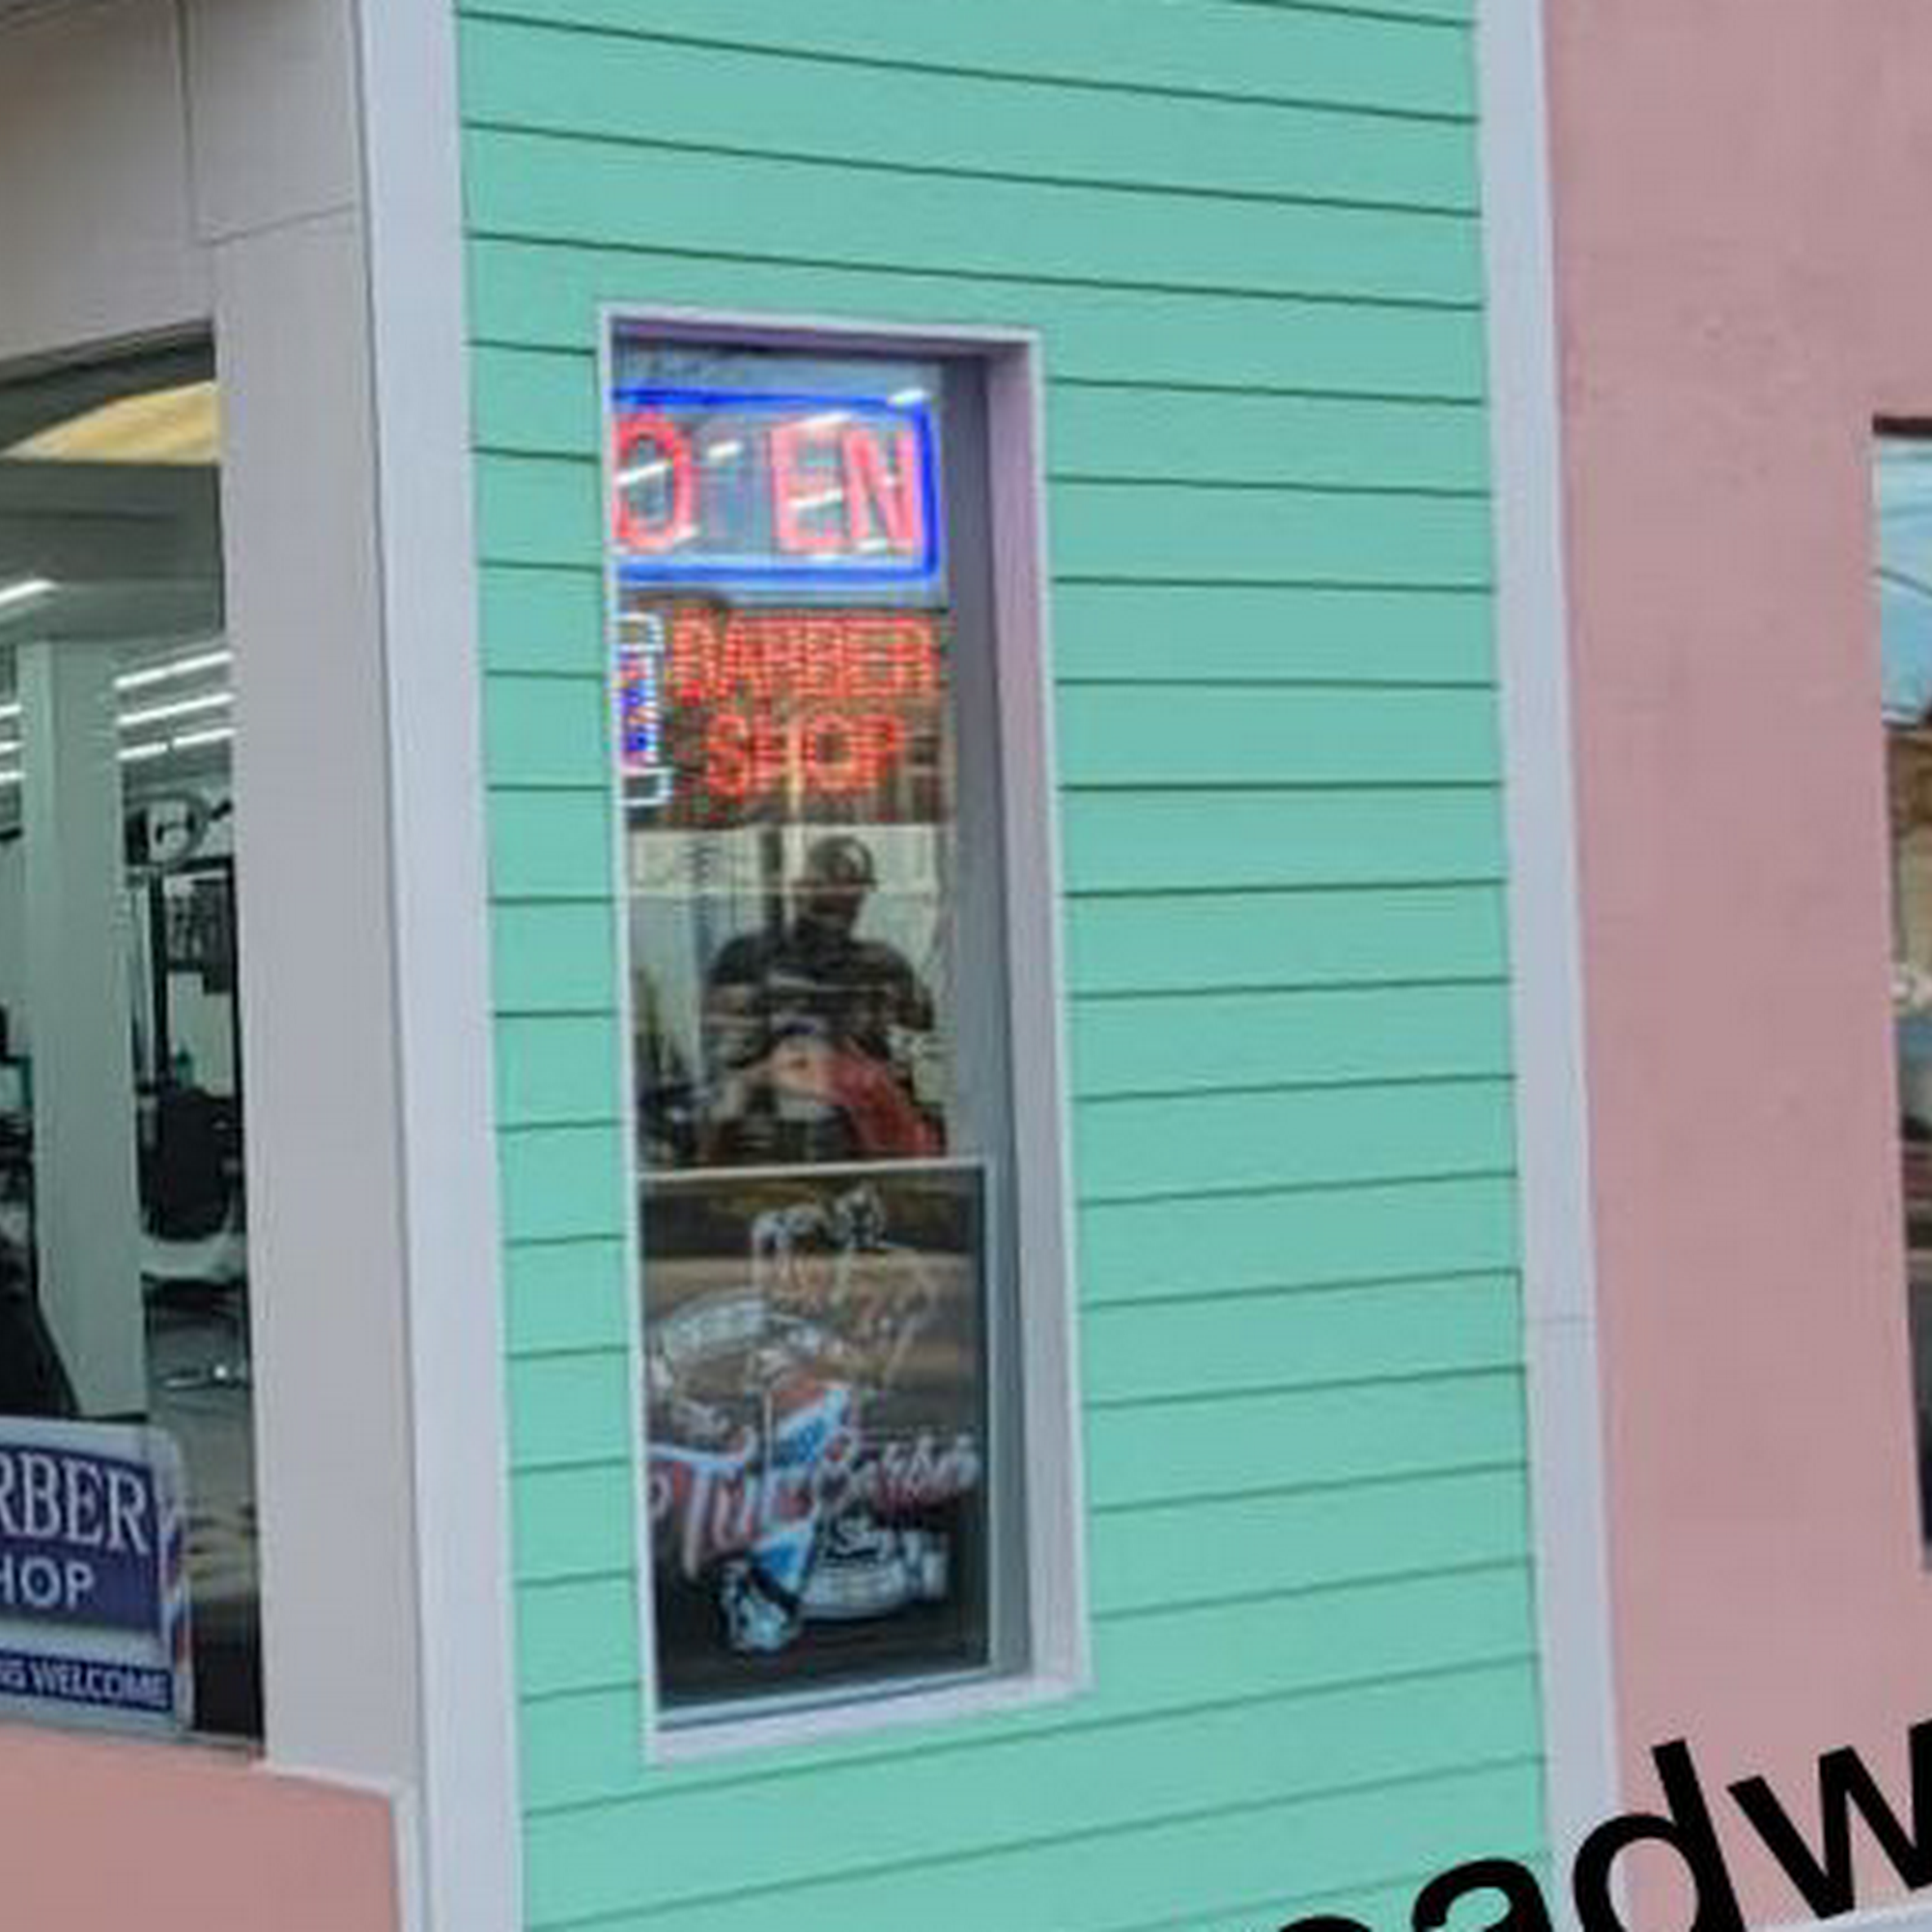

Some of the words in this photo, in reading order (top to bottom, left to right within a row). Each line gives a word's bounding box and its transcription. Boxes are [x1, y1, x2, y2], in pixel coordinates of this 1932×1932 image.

[612, 413, 921, 553] OEN
[672, 611, 935, 699] BARBER
[706, 713, 903, 792] SHOP
[30, 1660, 168, 1706] WELCOME
